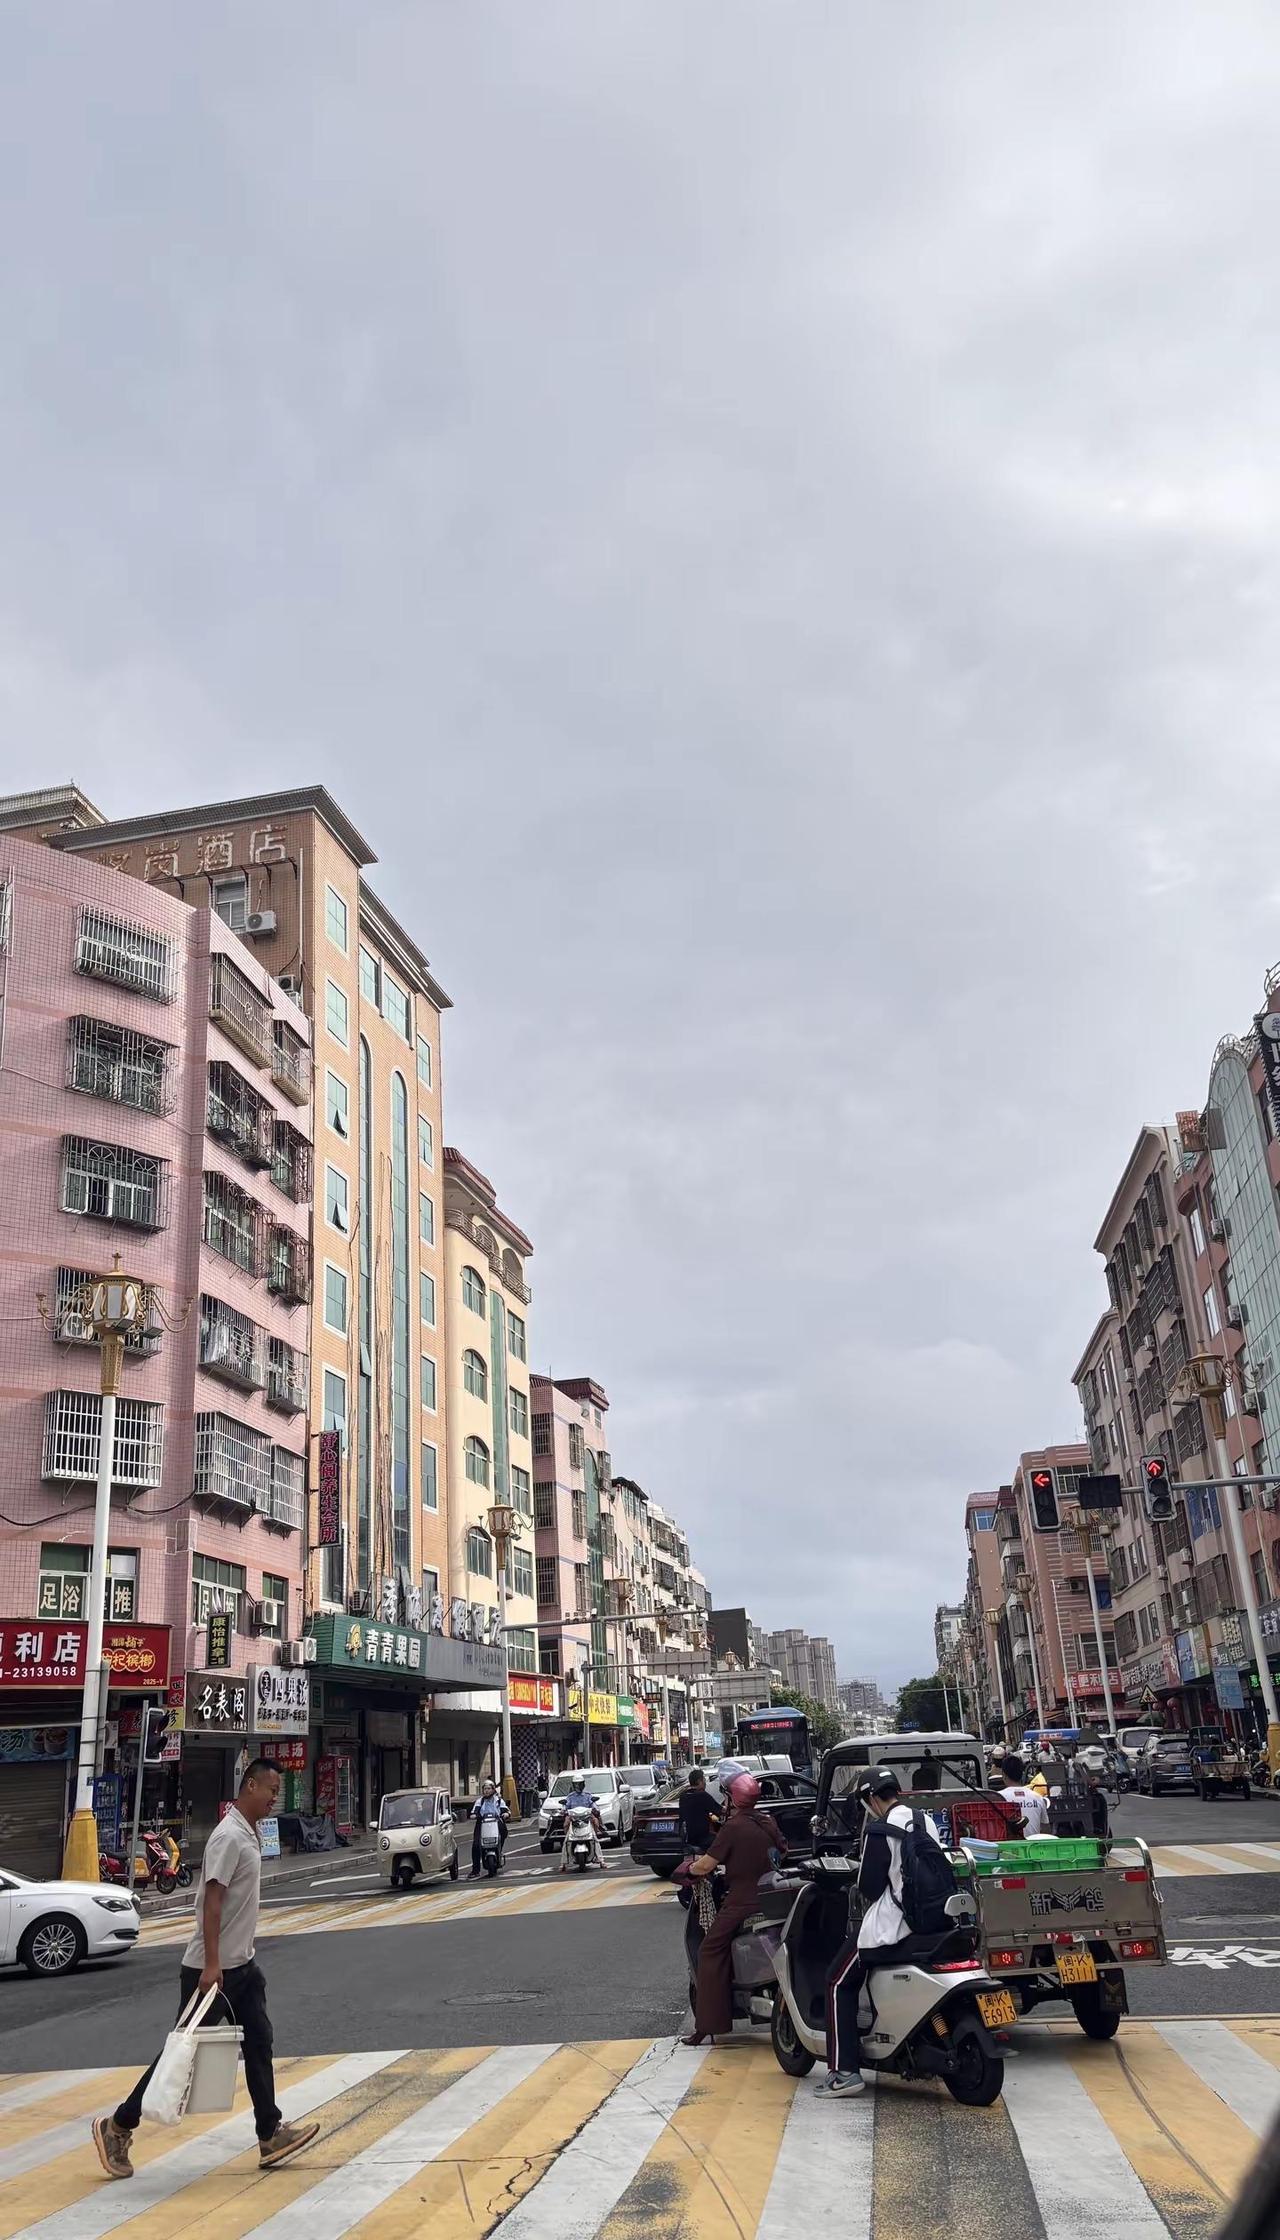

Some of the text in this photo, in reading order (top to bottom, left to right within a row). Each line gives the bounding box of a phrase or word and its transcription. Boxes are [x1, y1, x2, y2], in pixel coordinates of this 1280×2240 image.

[0, 1631, 82, 1663] 利店
[365, 1629, 421, 1669] 青青果园
[198, 1683, 246, 1721] 名表阁
[264, 1742, 304, 1758] 四果汤
[1061, 1967, 1095, 1982] H3111
[984, 2006, 1016, 2025] F6913
